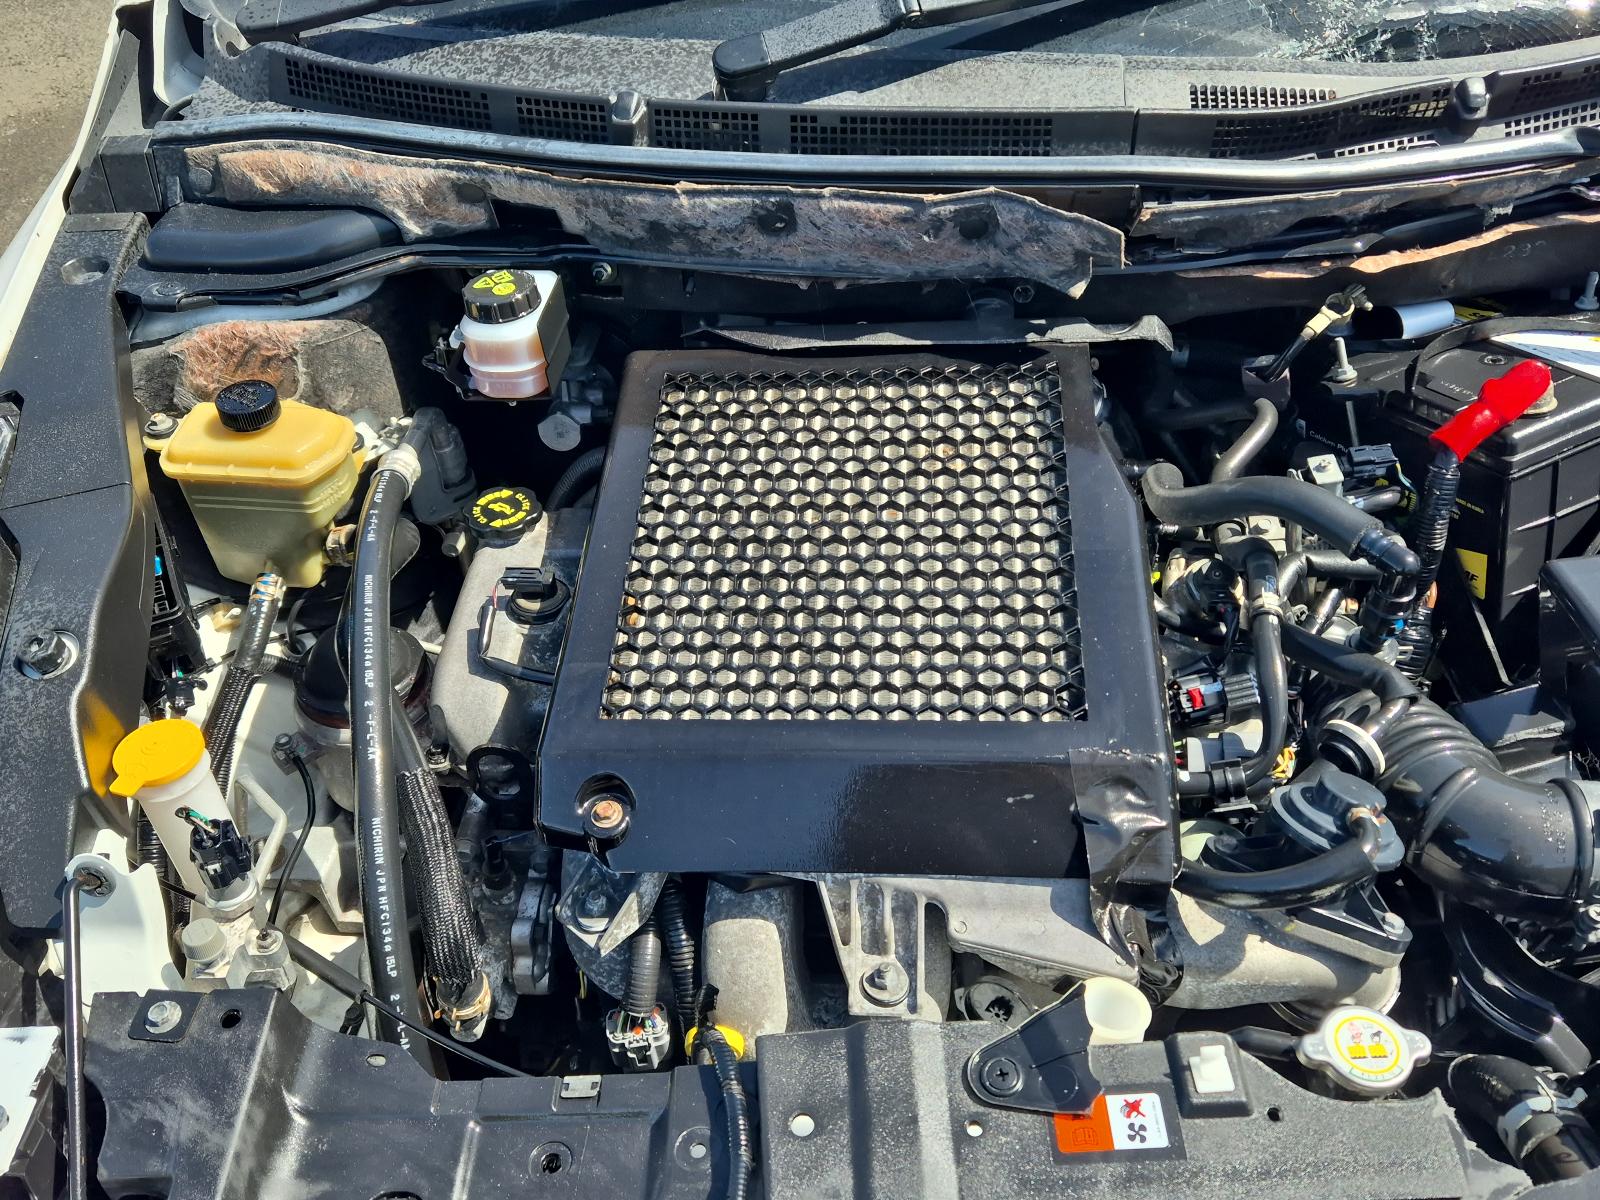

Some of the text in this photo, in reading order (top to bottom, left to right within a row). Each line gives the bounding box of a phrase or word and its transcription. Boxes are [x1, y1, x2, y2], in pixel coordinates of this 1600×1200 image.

[1310, 430, 1349, 453] Calcium Plu
[515, 493, 530, 511] CLICK
[472, 506, 488, 524] CLICK
[363, 607, 373, 623] JPN
[363, 625, 374, 667] HFC134a
[371, 817, 385, 865] NICHIRIN
[375, 869, 387, 893] JPN
[378, 896, 393, 952] HFC134a
[385, 955, 398, 978] 15LP
